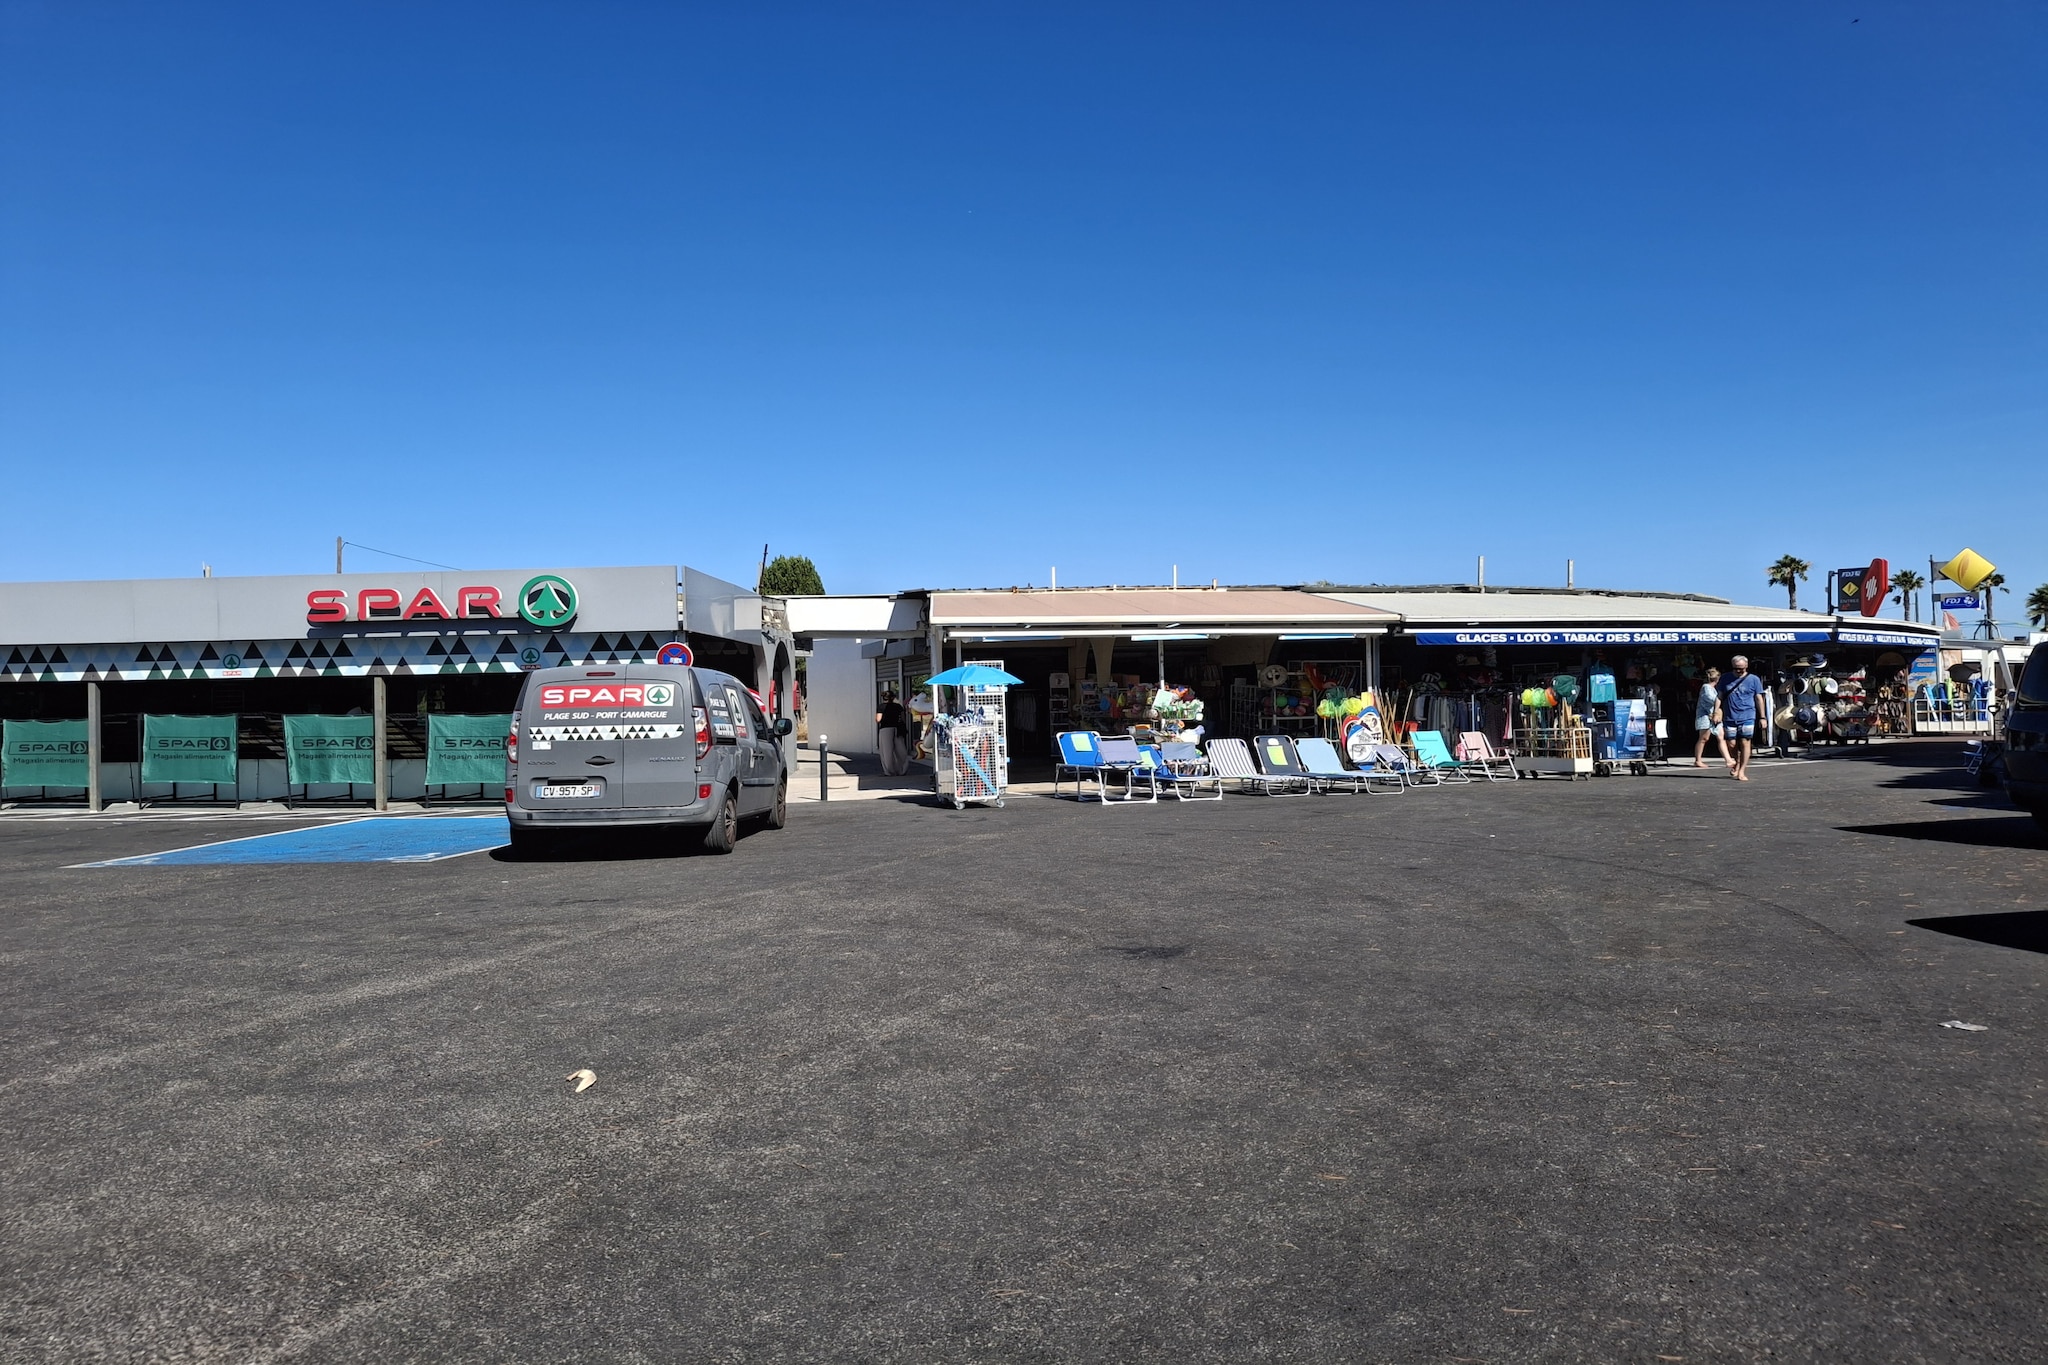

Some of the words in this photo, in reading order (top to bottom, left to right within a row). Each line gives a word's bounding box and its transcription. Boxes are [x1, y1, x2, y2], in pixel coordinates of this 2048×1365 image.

[307, 586, 502, 622] SPAR
[1945, 597, 1961, 605] FDJ
[1456, 633, 1507, 643] GLACES
[1517, 633, 1550, 643] LOTO
[1563, 633, 1604, 643] TABAC
[1606, 633, 1630, 643] DES
[1633, 633, 1679, 642] SABLES
[1688, 632, 1732, 642] PRESSE
[1740, 632, 1796, 642] E-LIQUIDE
[543, 688, 643, 704] SPAR
[620, 711, 668, 719] CAMARGUE
[157, 739, 210, 748] SPAR
[302, 738, 355, 748] SPAR
[444, 738, 501, 748] SPAR
[18, 743, 71, 753] SPAR
[153, 752, 184, 761] Magasin
[298, 752, 327, 760] Magasin
[438, 753, 472, 761] Magasin
[13, 757, 45, 765] Magasin
